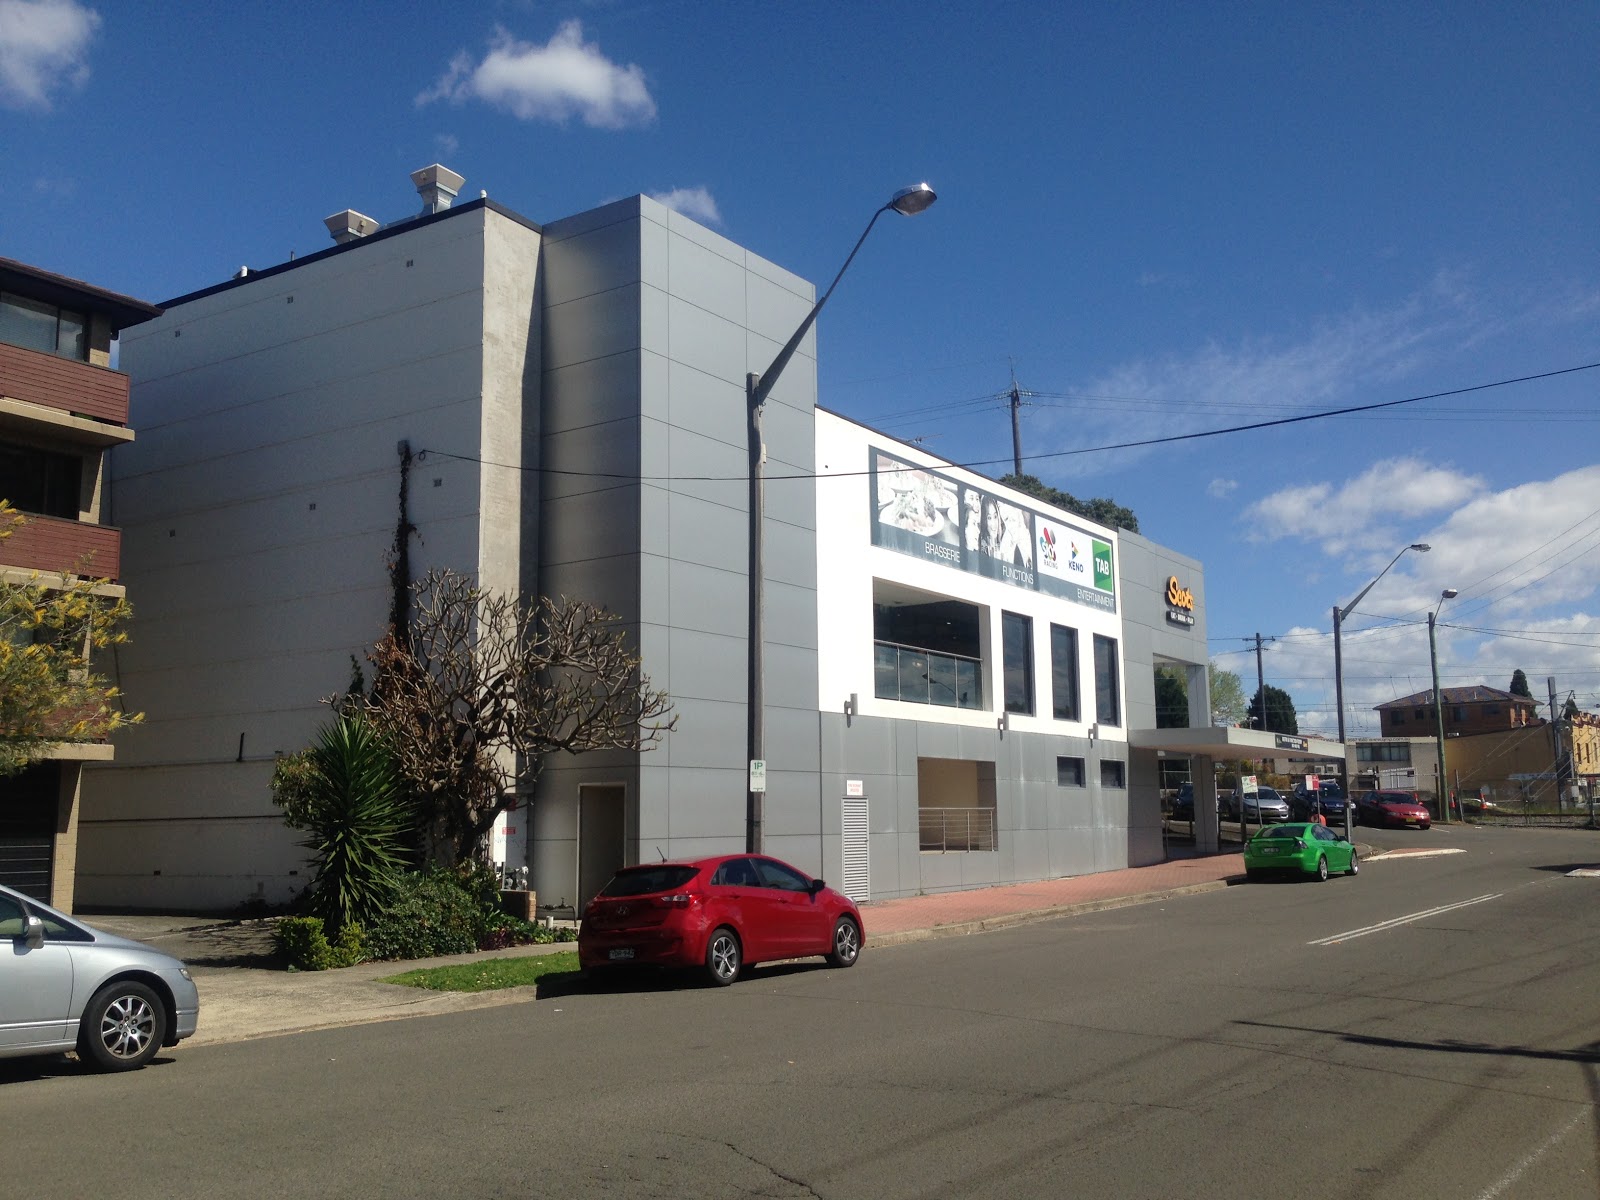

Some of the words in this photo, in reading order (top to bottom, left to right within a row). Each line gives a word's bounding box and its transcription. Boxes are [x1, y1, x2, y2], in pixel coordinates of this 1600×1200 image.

[925, 541, 960, 563] BRASSERIE
[1002, 565, 1034, 585] FUNCTIONS
[1068, 560, 1084, 573] KENO
[1095, 557, 1110, 576] TAB
[1077, 588, 1114, 607] ENTERTAINMENT
[754, 762, 763, 770] 1P
